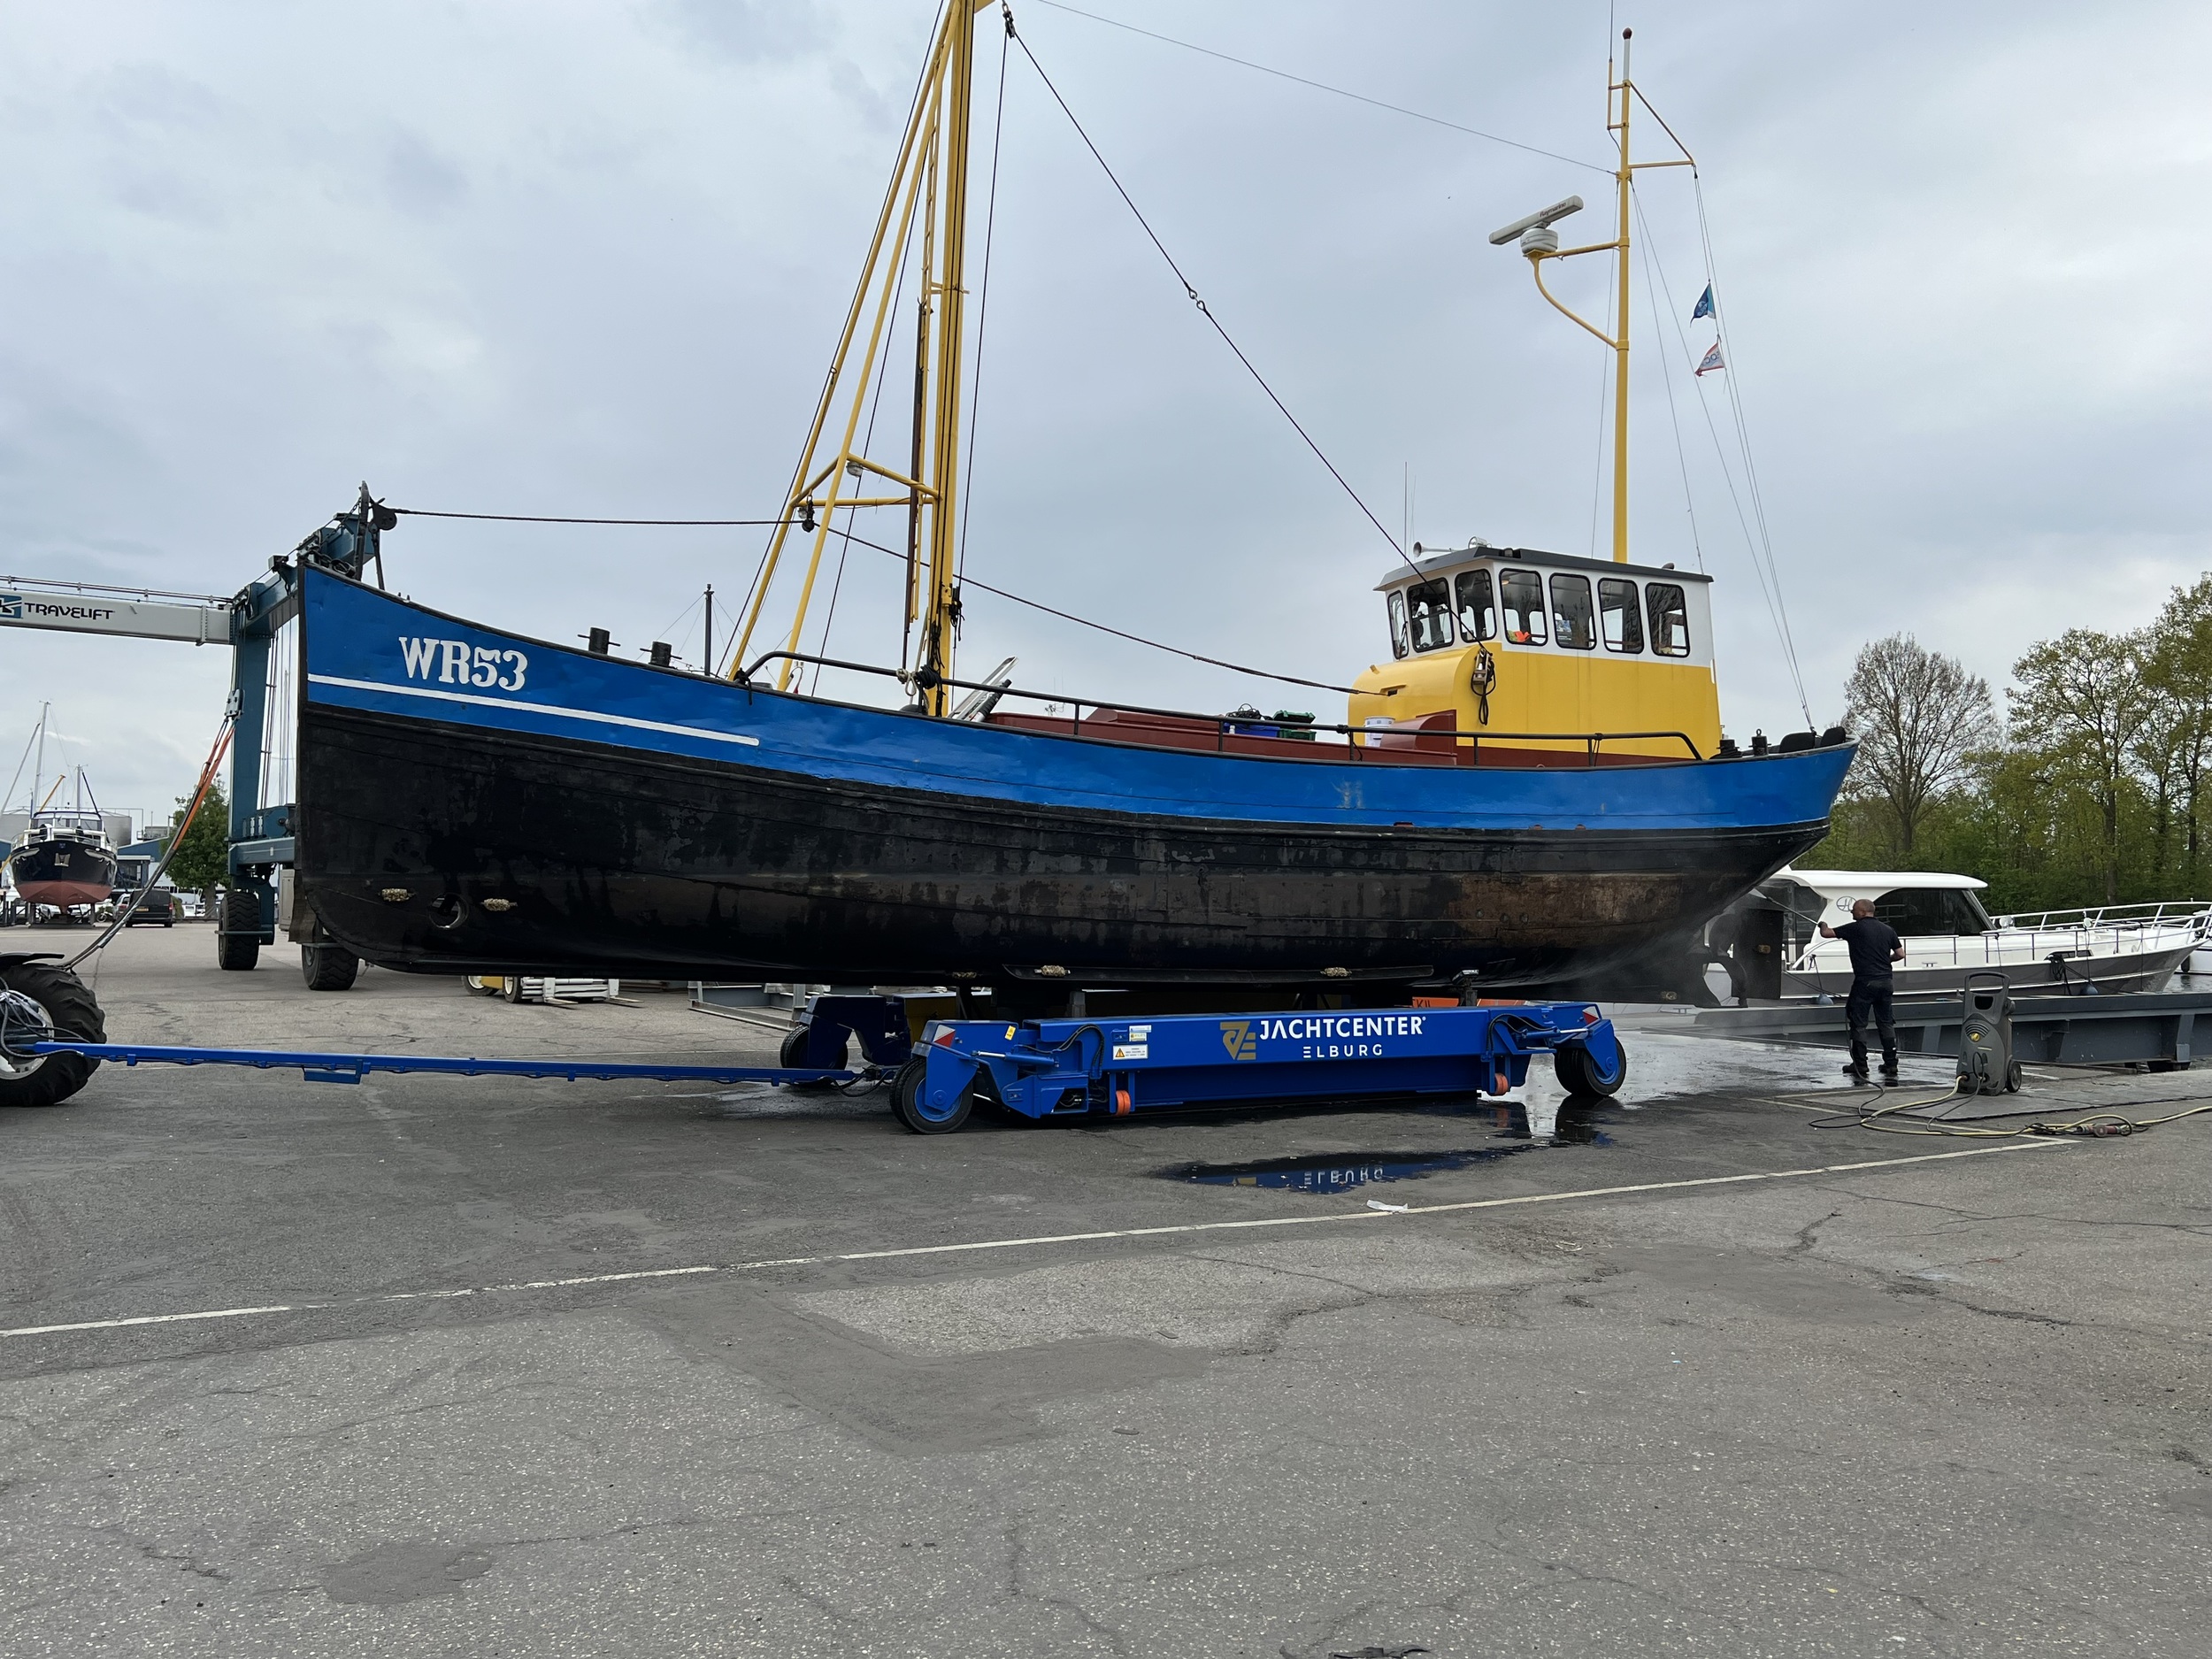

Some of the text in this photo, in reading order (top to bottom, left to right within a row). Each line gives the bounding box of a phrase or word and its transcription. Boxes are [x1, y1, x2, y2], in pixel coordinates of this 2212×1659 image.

[24, 603, 114, 620] TRAVELIFT
[398, 636, 528, 692] WR53
[1259, 1017, 1423, 1041] JACHTCENTER
[1302, 1043, 1383, 1059] ELBURG
